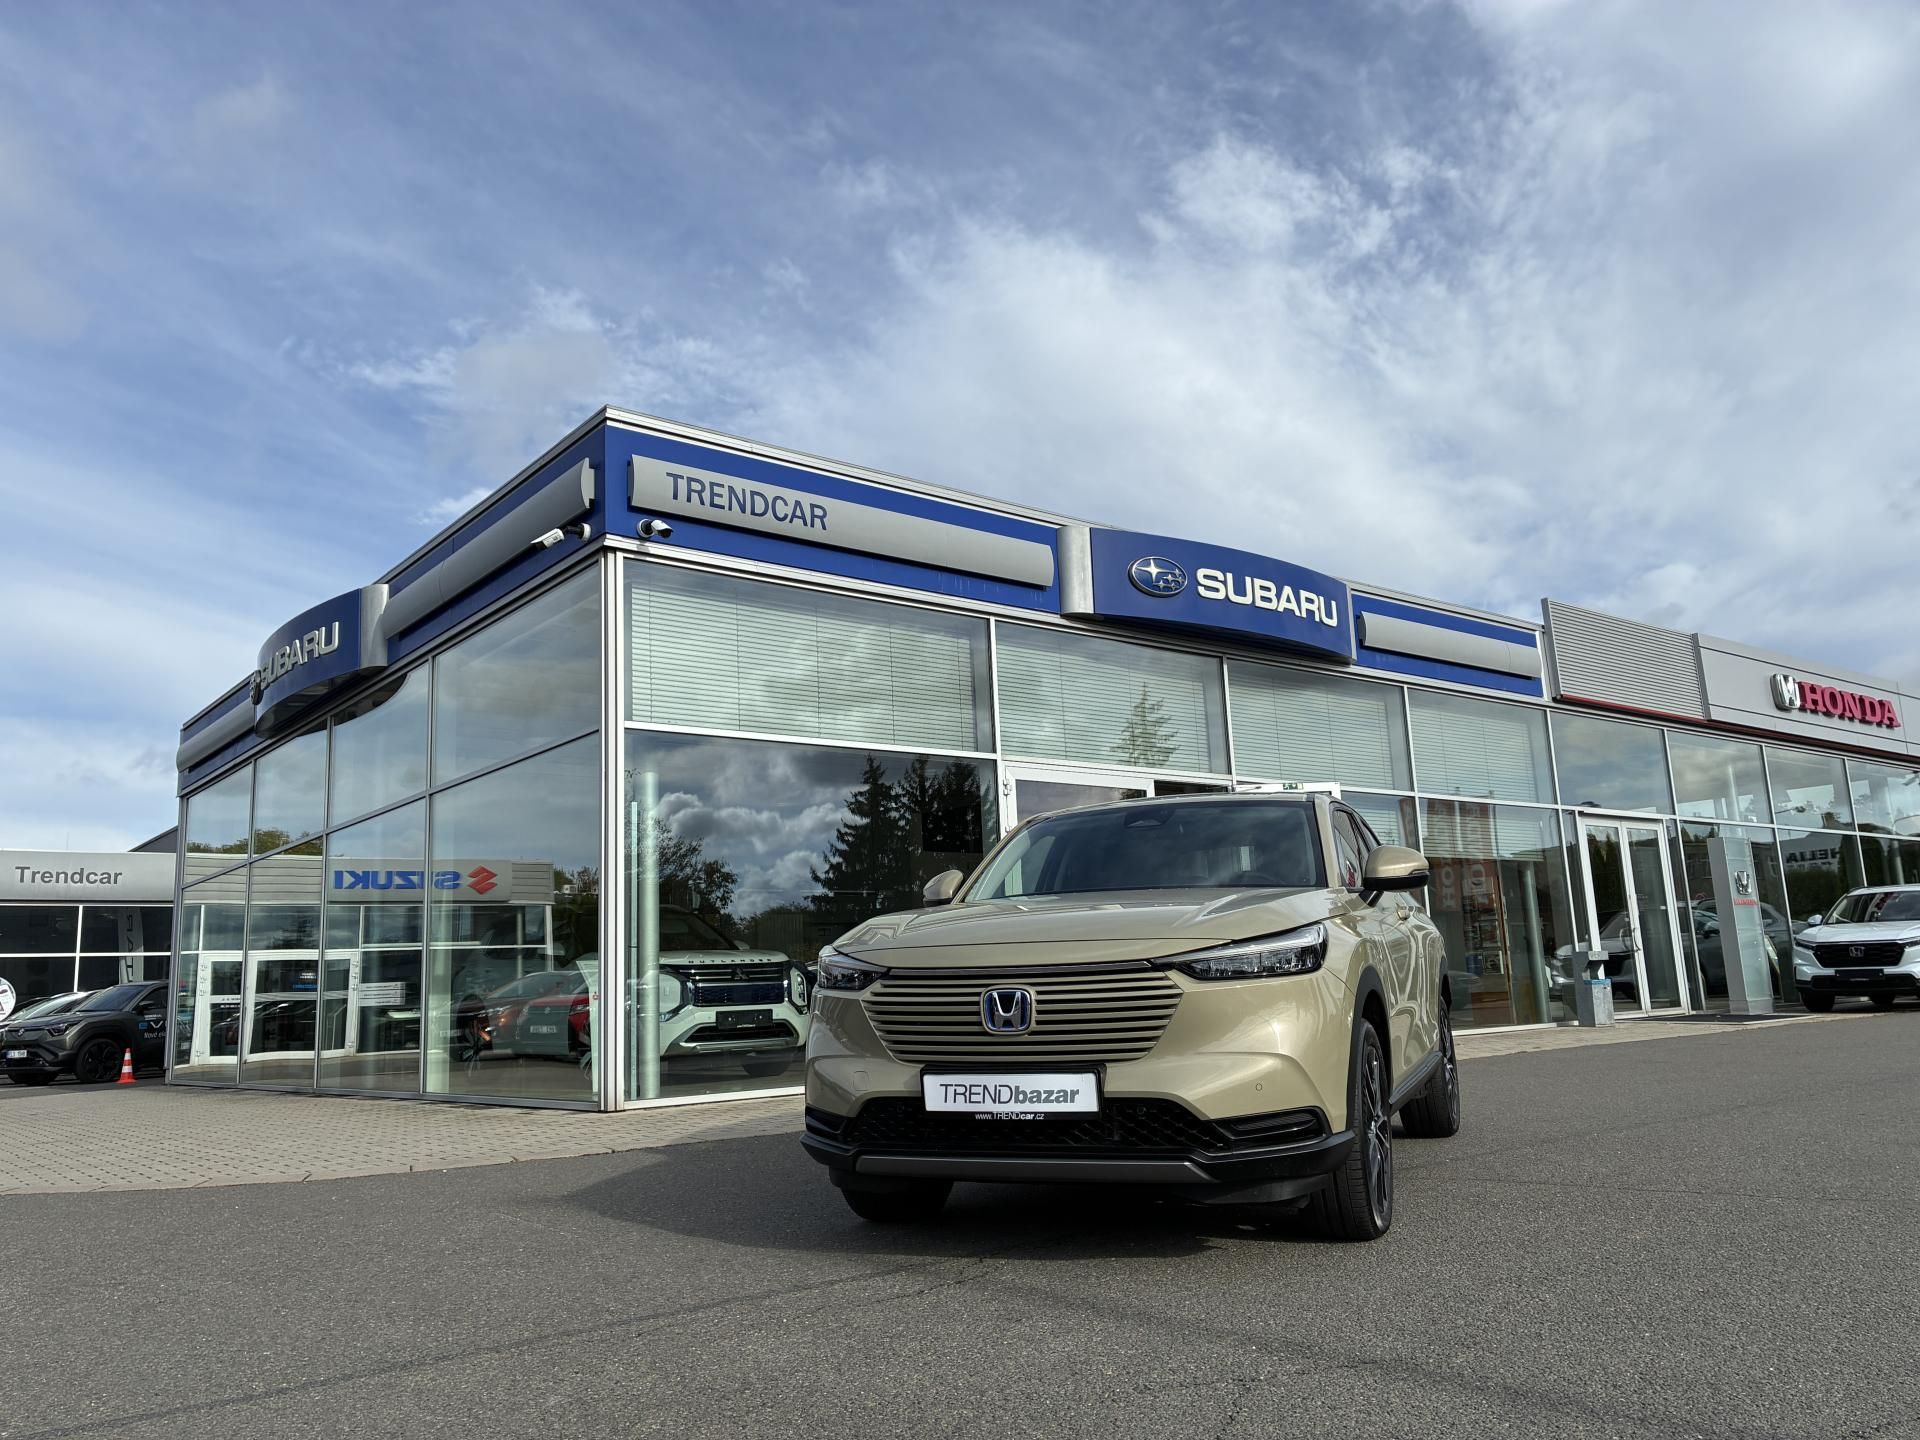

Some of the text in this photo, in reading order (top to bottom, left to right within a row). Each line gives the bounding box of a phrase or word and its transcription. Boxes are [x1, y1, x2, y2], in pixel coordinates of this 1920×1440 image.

[666, 472, 828, 530] TRENDCAR
[1196, 568, 1338, 627] SUBARU
[1801, 681, 1901, 728] HONDA
[15, 866, 123, 885] Trendcar
[940, 1083, 1079, 1105] TRENDbazar
[975, 1111, 1045, 1120] www.TRENDcar.cz
